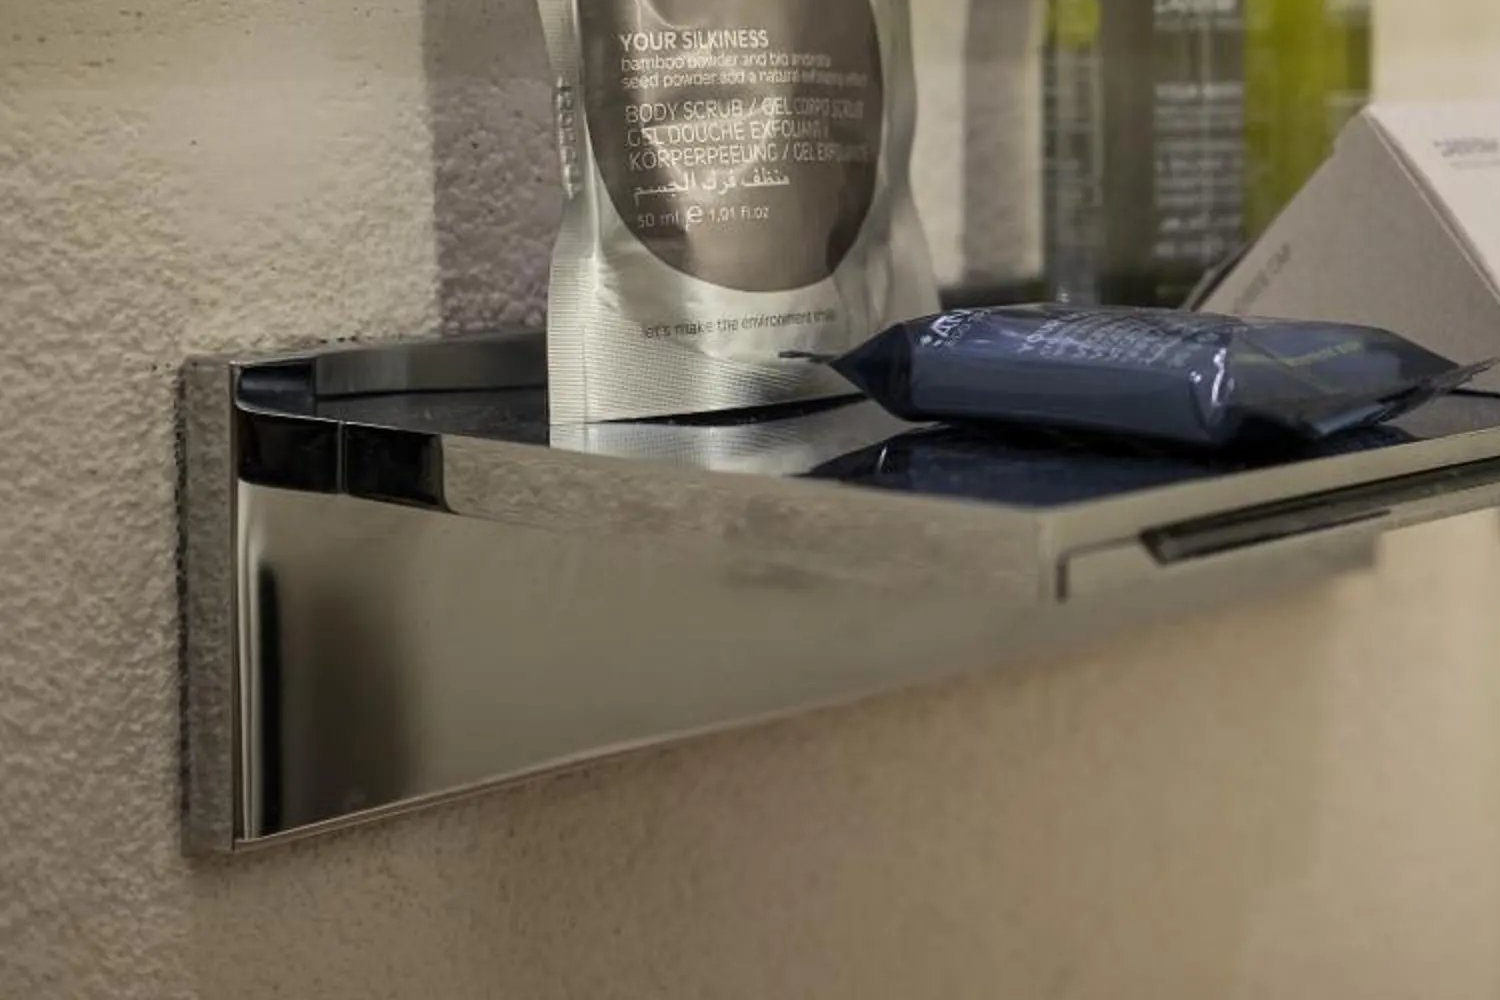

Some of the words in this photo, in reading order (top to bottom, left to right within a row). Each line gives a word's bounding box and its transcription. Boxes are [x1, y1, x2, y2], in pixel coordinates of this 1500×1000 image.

[620, 32, 677, 51] YOUR
[682, 29, 769, 49] SILKINESS
[621, 54, 685, 72] bamboo
[742, 51, 767, 67] and
[622, 72, 659, 89] seed
[663, 72, 717, 88] powder
[625, 102, 679, 123] BODY
[683, 99, 744, 120] SCRUB
[761, 96, 793, 116] GEL
[667, 119, 746, 144] DOUCHE
[660, 210, 679, 226] ml
[716, 315, 739, 333] the
